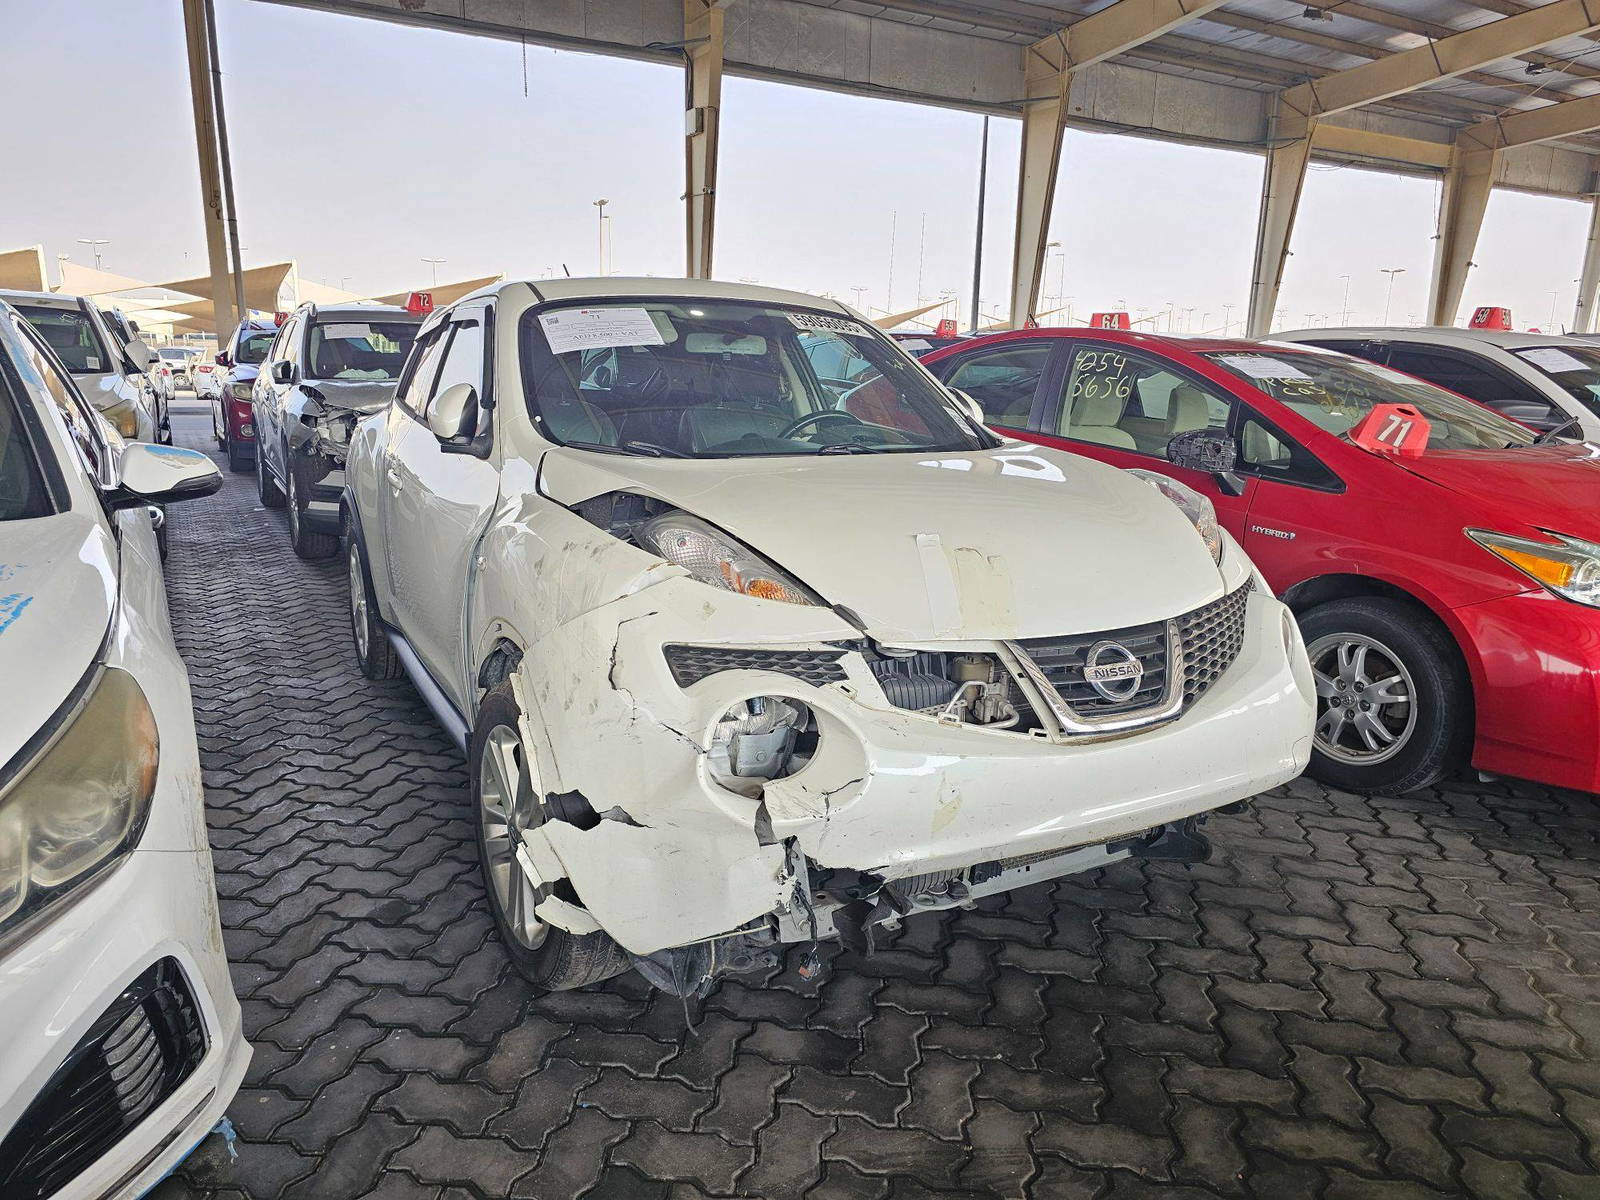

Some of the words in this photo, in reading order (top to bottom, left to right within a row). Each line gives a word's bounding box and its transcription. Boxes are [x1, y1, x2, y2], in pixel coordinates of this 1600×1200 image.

[418, 293, 430, 307] 72
[1102, 314, 1119, 329] 64
[1075, 350, 1126, 377] 4254
[1072, 373, 1130, 399] 5656
[1377, 414, 1413, 448] 71
[1251, 525, 1287, 538] HYBRID
[1094, 664, 1140, 678] NISSAN
